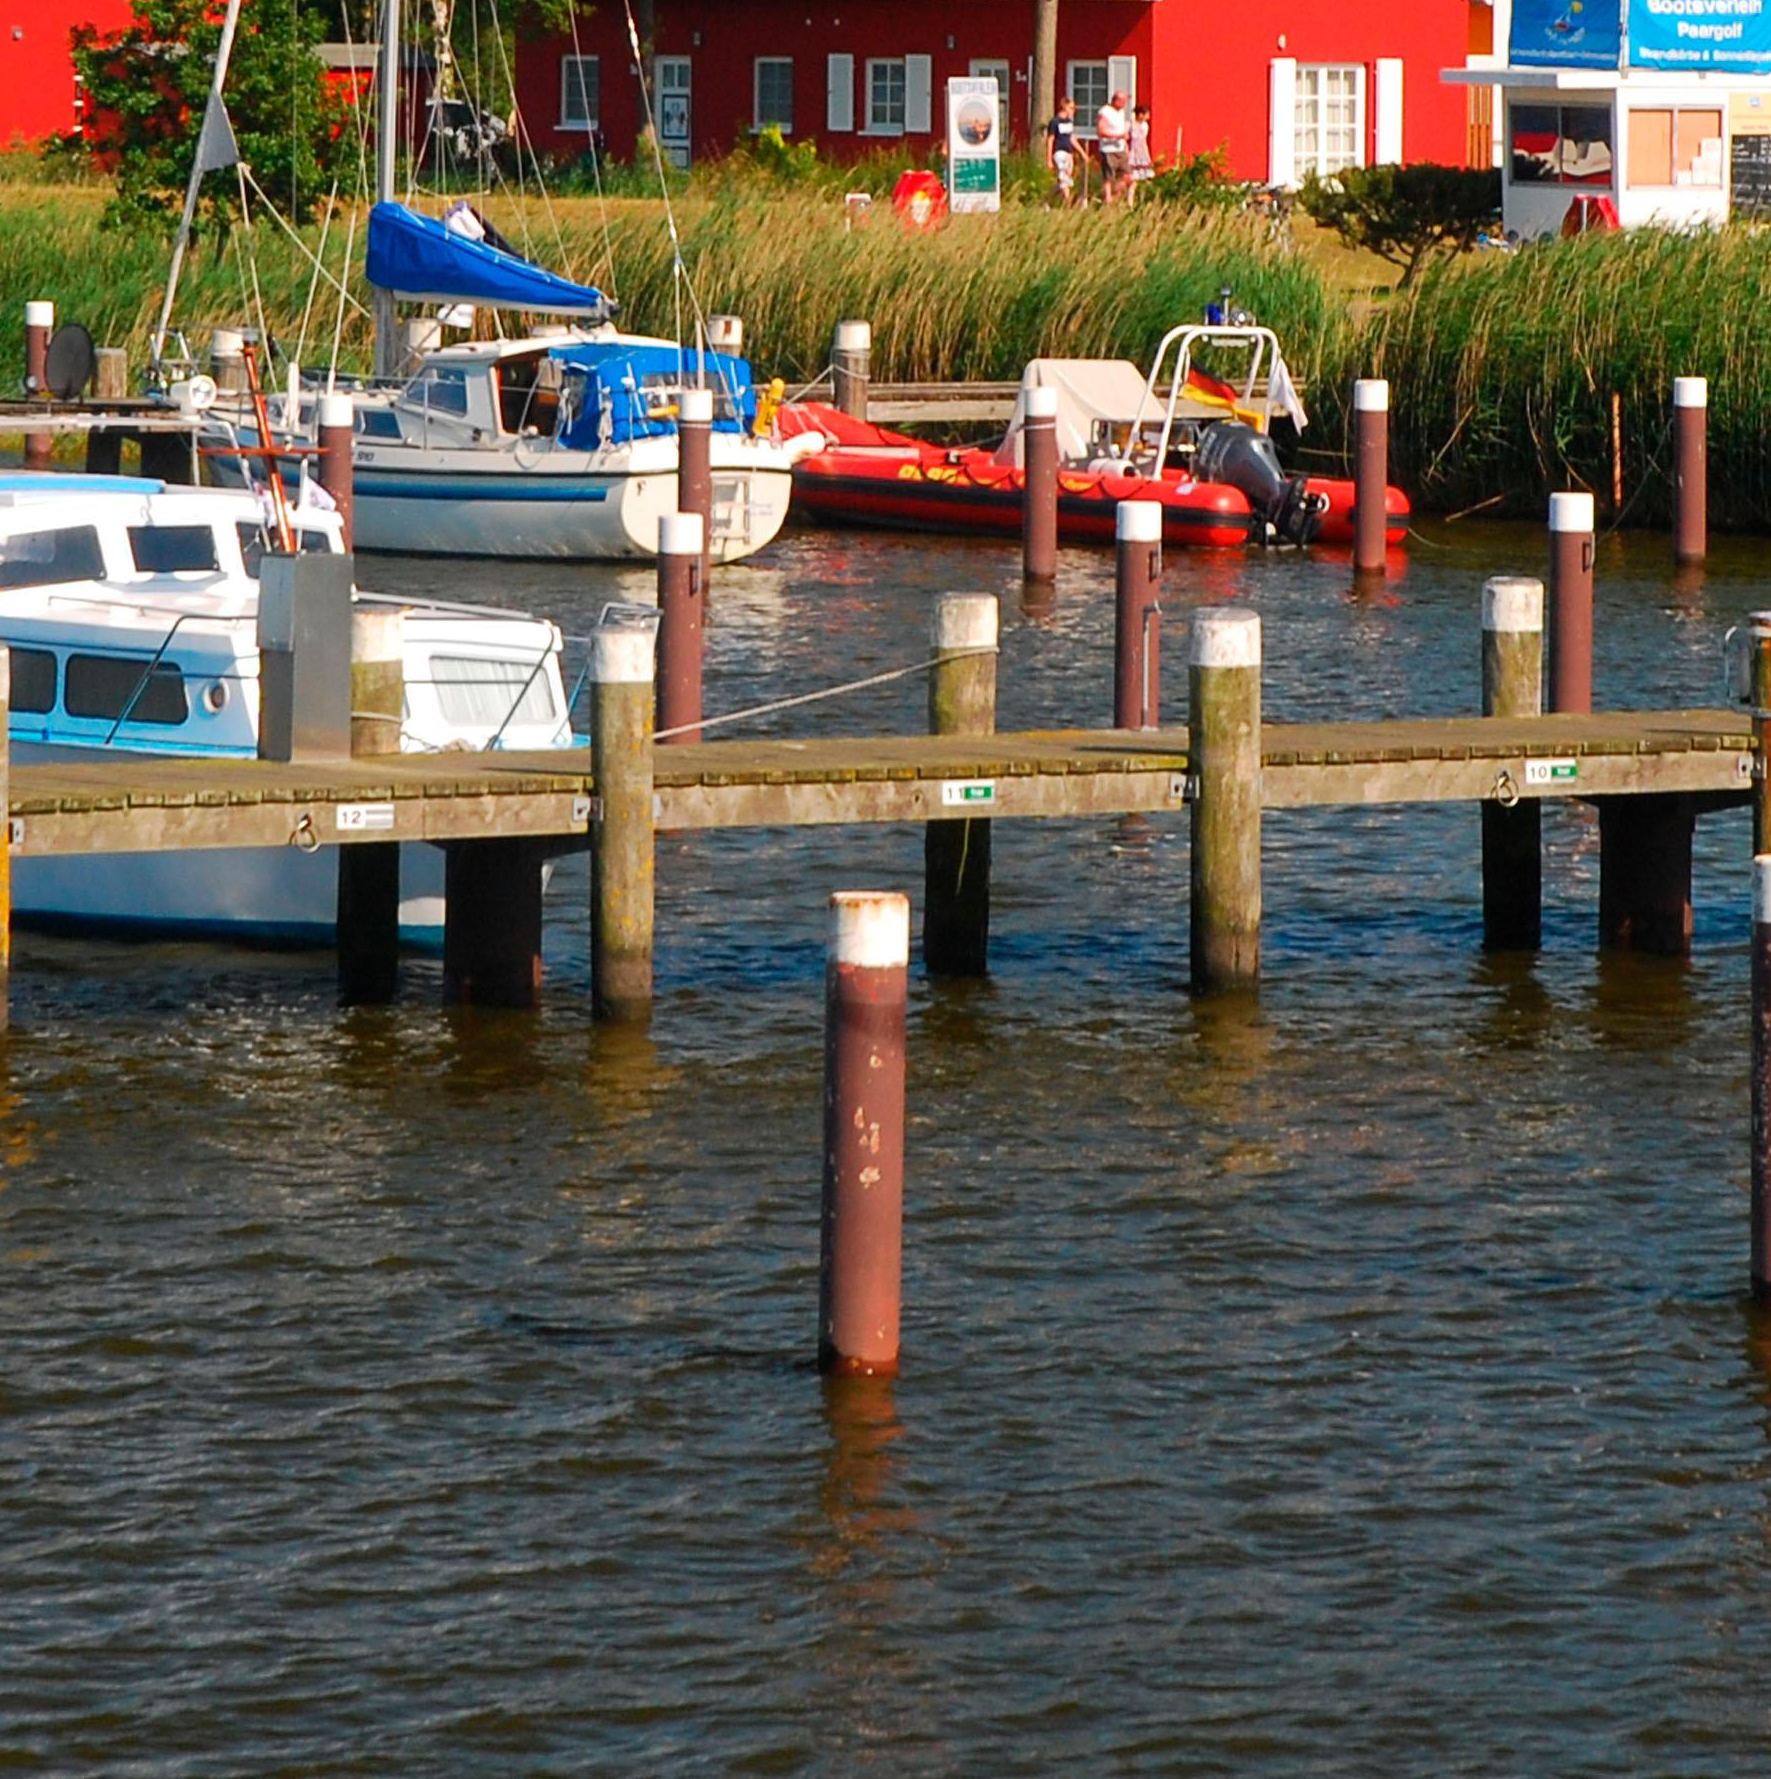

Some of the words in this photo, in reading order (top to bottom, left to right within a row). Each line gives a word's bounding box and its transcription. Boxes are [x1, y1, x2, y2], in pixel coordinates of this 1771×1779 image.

[1677, 21, 1743, 42] Paargolf
[1530, 766, 1547, 778] 10
[342, 810, 361, 824] 12
